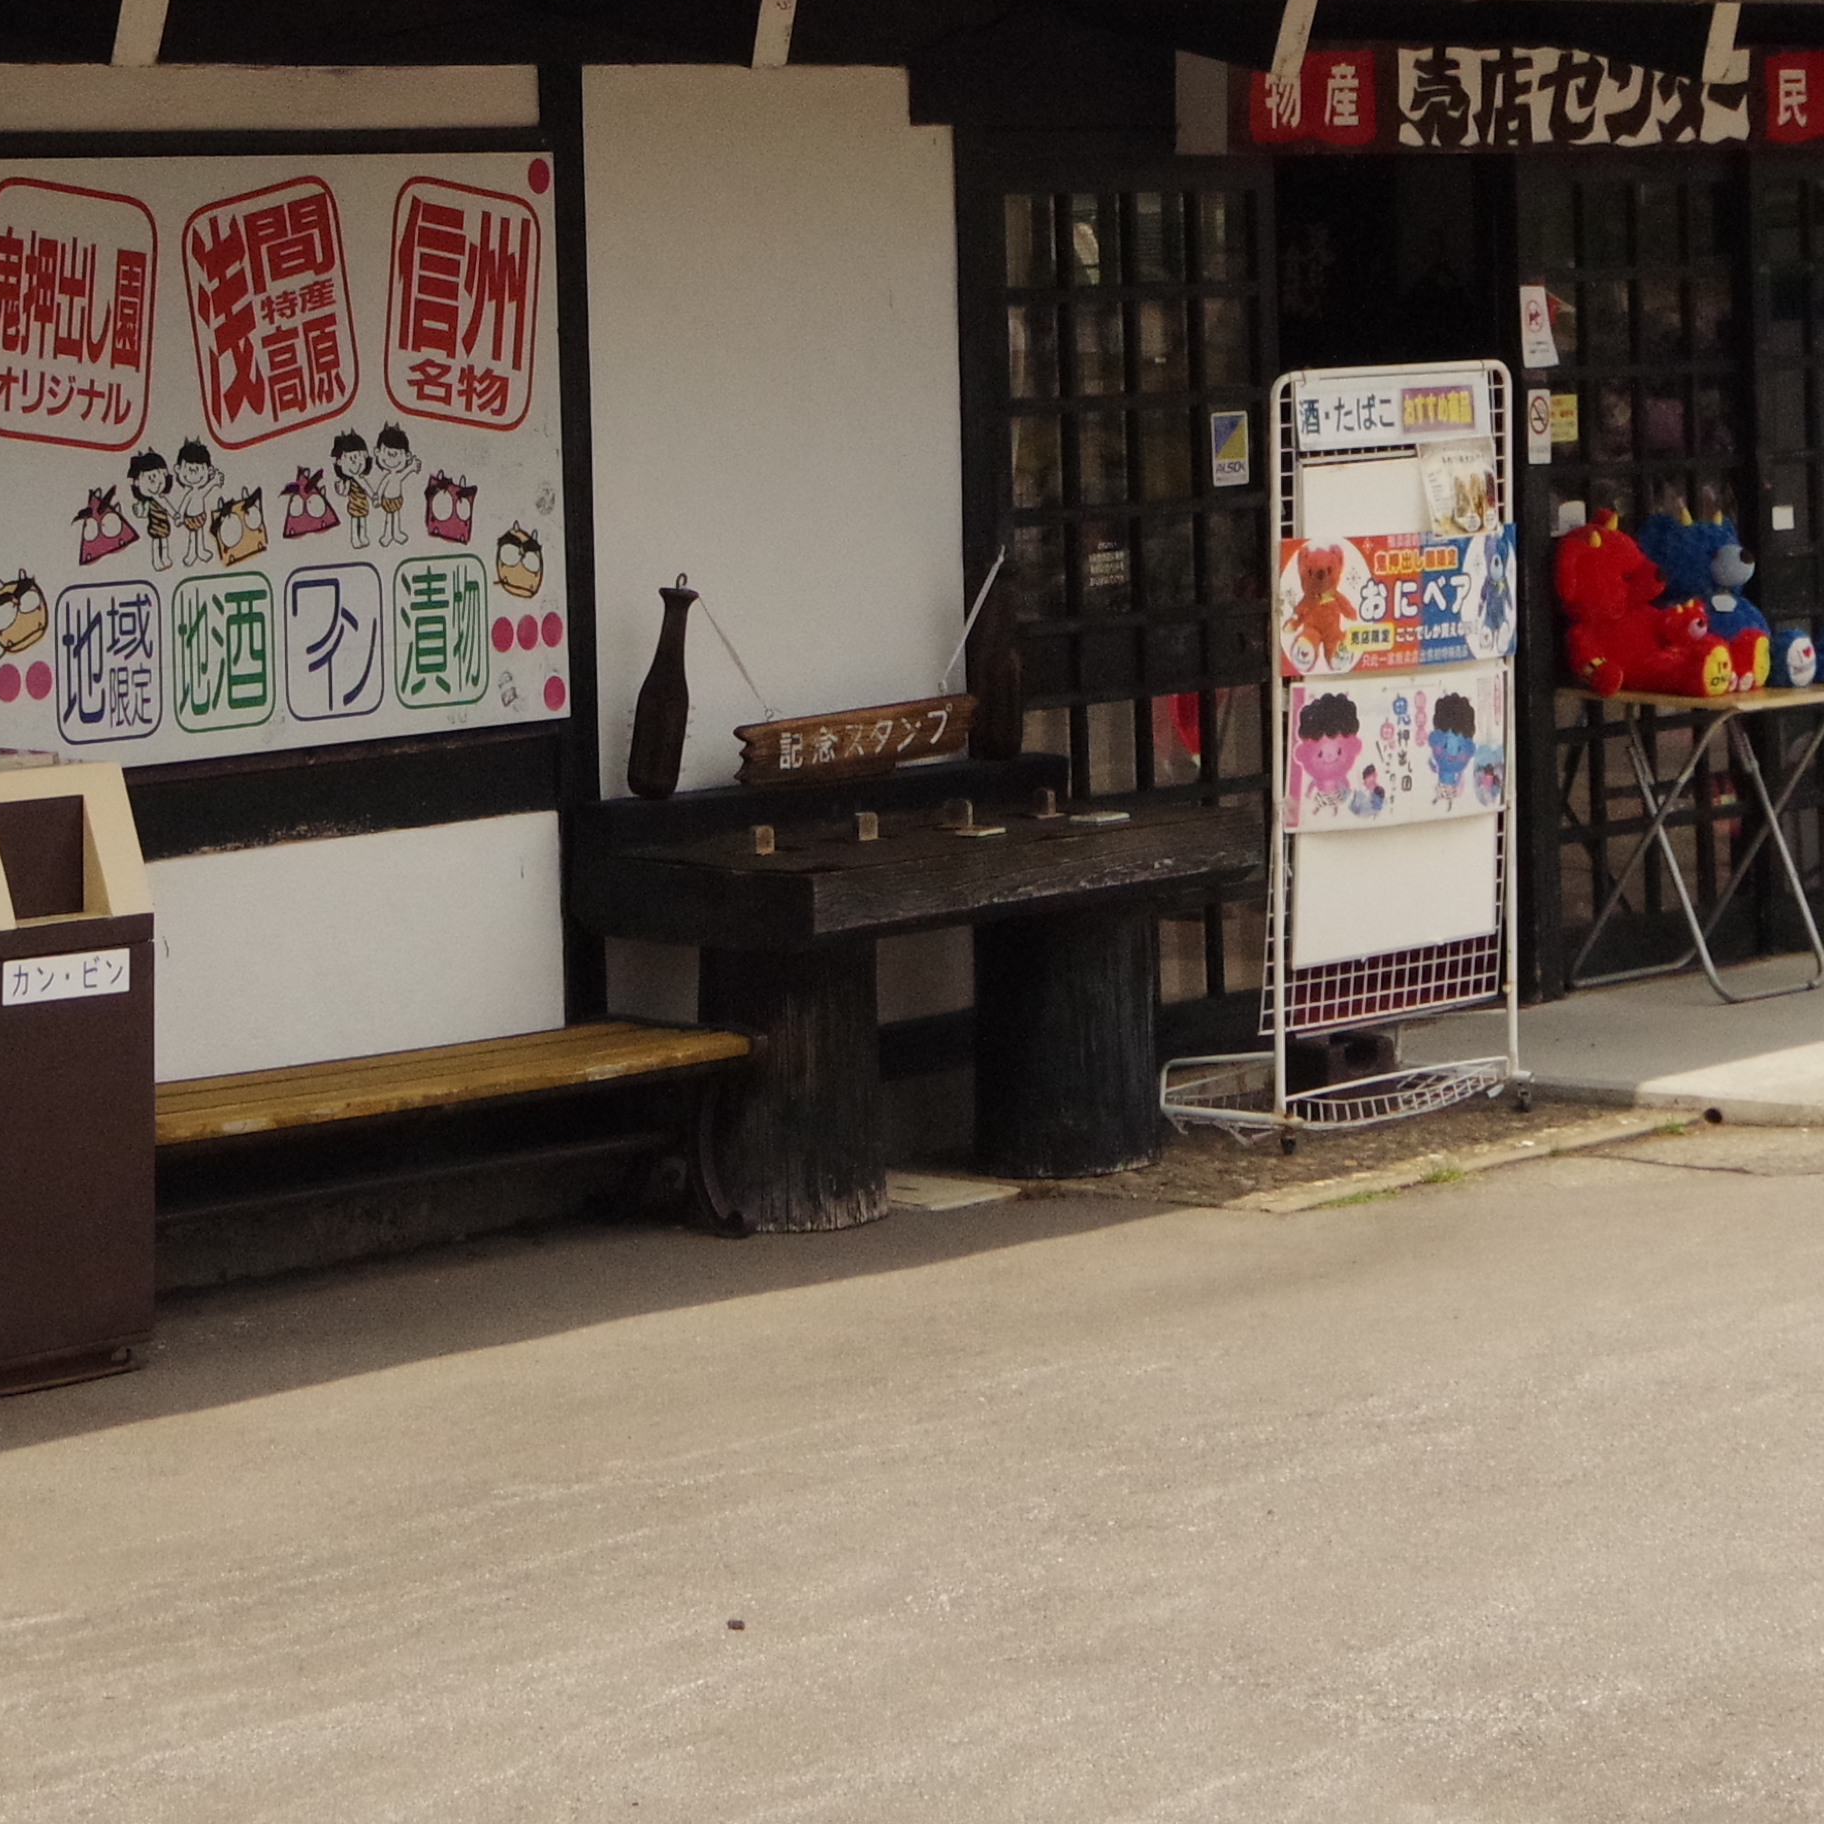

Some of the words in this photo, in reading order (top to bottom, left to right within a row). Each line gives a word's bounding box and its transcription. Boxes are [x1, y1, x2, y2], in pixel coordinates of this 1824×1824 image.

[1264, 63, 1360, 129] 物産
[260, 279, 338, 322] 特産
[398, 195, 531, 371] 信州
[407, 358, 510, 417] 名物
[397, 564, 480, 695] 漬物
[1360, 573, 1472, 622] おにベア
[178, 587, 268, 717] 地酒
[291, 577, 378, 710] ワイン
[778, 702, 954, 770] 記念スタンプ
[12, 956, 124, 996] カン・ビン
